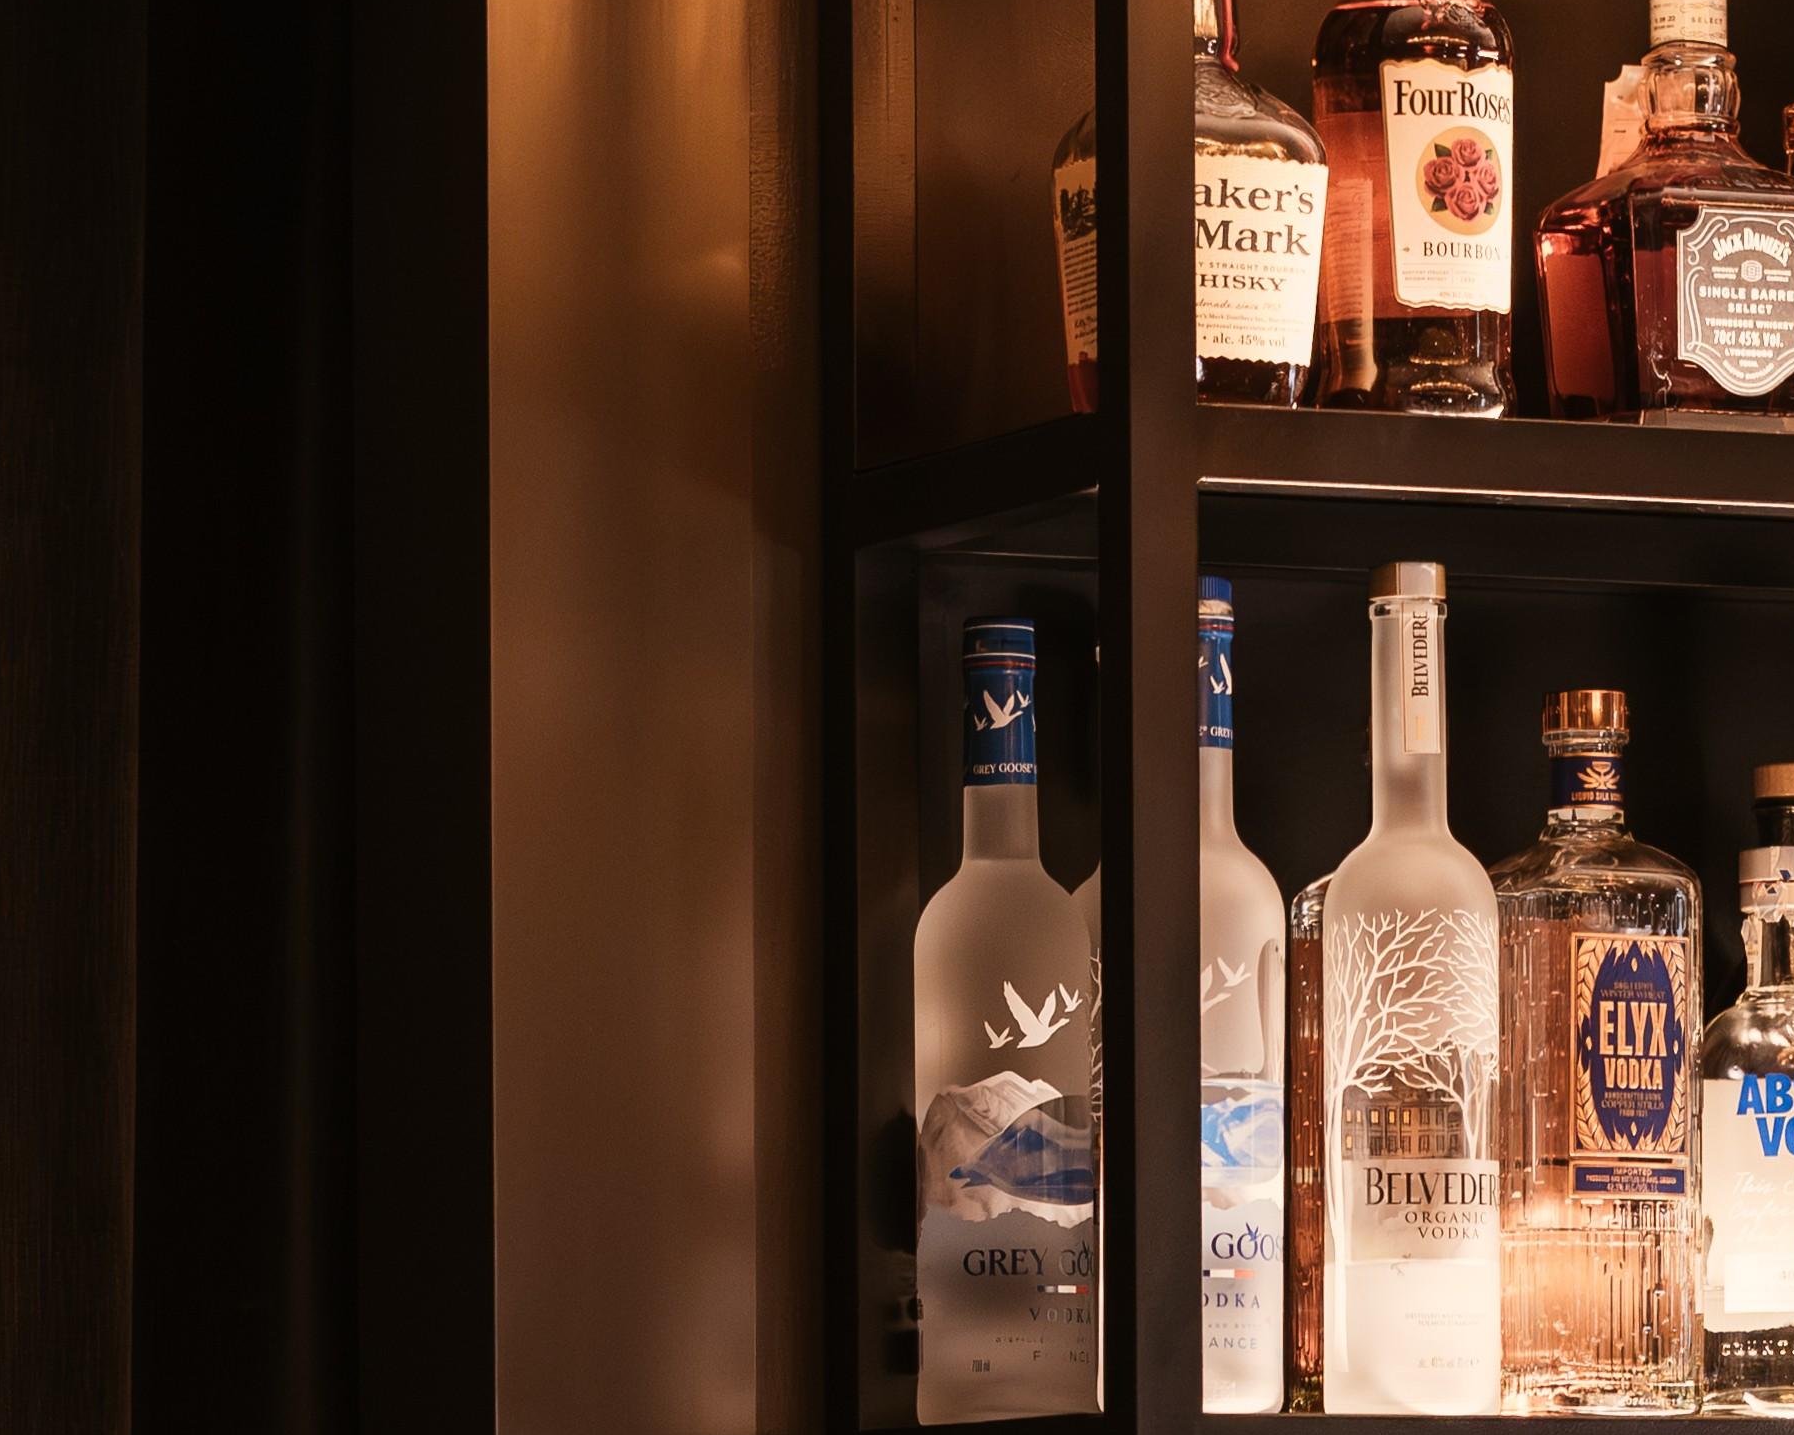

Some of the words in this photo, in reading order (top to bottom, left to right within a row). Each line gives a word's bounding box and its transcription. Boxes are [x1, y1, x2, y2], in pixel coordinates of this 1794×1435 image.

[1195, 178, 1314, 215] aker's
[1196, 218, 1311, 256] Mark
[1711, 232, 1744, 261] JACK
[1743, 227, 1792, 267] DANIEL'S
[1423, 241, 1501, 261] BOURBON
[1209, 261, 1259, 271] STRAIGHT
[1196, 272, 1287, 292] HISKY
[1698, 285, 1746, 300] SINGLE
[1727, 303, 1773, 314] SELECT
[1212, 332, 1234, 345] alc.
[1237, 334, 1265, 346] 45%
[1713, 330, 1736, 345] 70cl
[1738, 331, 1761, 347] 45%
[1762, 333, 1784, 348] Vol.
[1411, 611, 1430, 698] BELVEDERE
[972, 763, 997, 775] GREY
[1599, 1000, 1668, 1058] ELYX
[1604, 1057, 1664, 1091] VODKA
[1363, 1166, 1499, 1212] BELVEDER
[1405, 1211, 1486, 1224] ORGANIC
[1418, 1226, 1480, 1240] VODKA
[962, 1248, 1049, 1277] GREY
